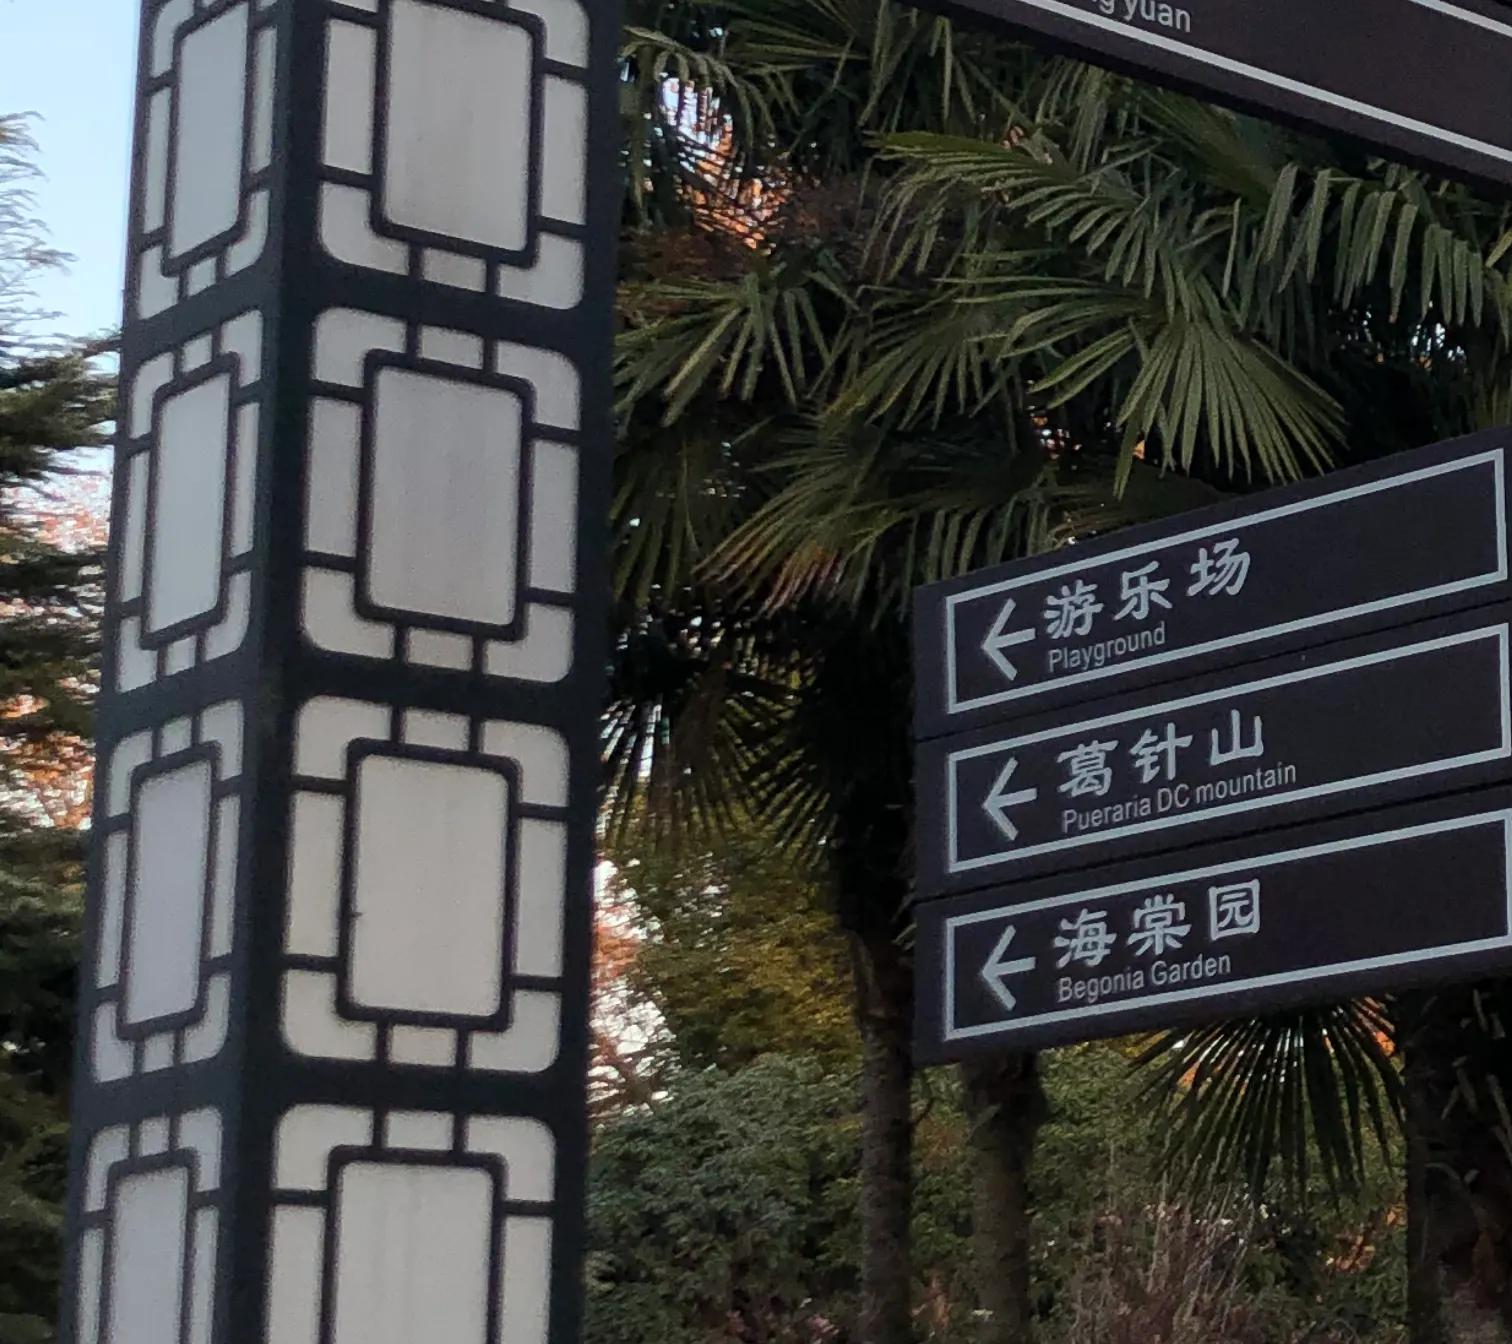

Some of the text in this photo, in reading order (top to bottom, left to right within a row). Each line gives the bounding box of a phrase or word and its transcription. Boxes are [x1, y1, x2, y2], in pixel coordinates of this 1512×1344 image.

[1043, 537, 1251, 640] 游乐场
[1048, 621, 1166, 674] Playground
[1057, 709, 1265, 799] 葛针山
[1062, 762, 1297, 833] Pueraria DC mountain
[1054, 879, 1261, 970] 海棠园
[1058, 954, 1231, 1006] Begonia Garden
